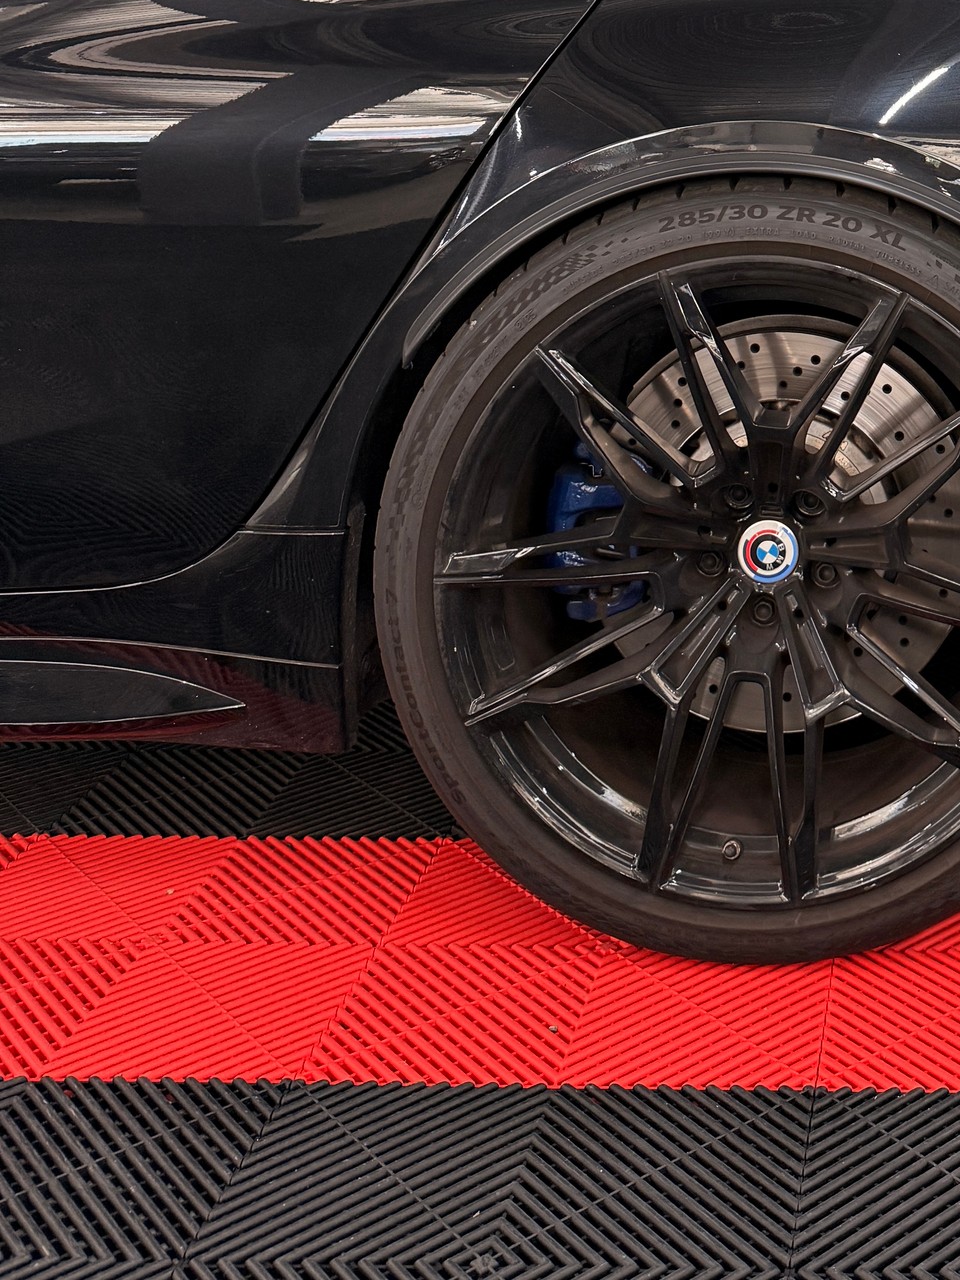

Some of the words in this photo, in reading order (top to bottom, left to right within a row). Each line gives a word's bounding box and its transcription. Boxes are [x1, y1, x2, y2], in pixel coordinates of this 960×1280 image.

[658, 204, 768, 233] 285/30
[776, 205, 816, 224] ZR
[822, 212, 863, 232] 20
[869, 223, 907, 252] XL
[744, 226, 781, 237] EXTRA
[385, 586, 399, 605] 7
[386, 616, 468, 807] SportContact
